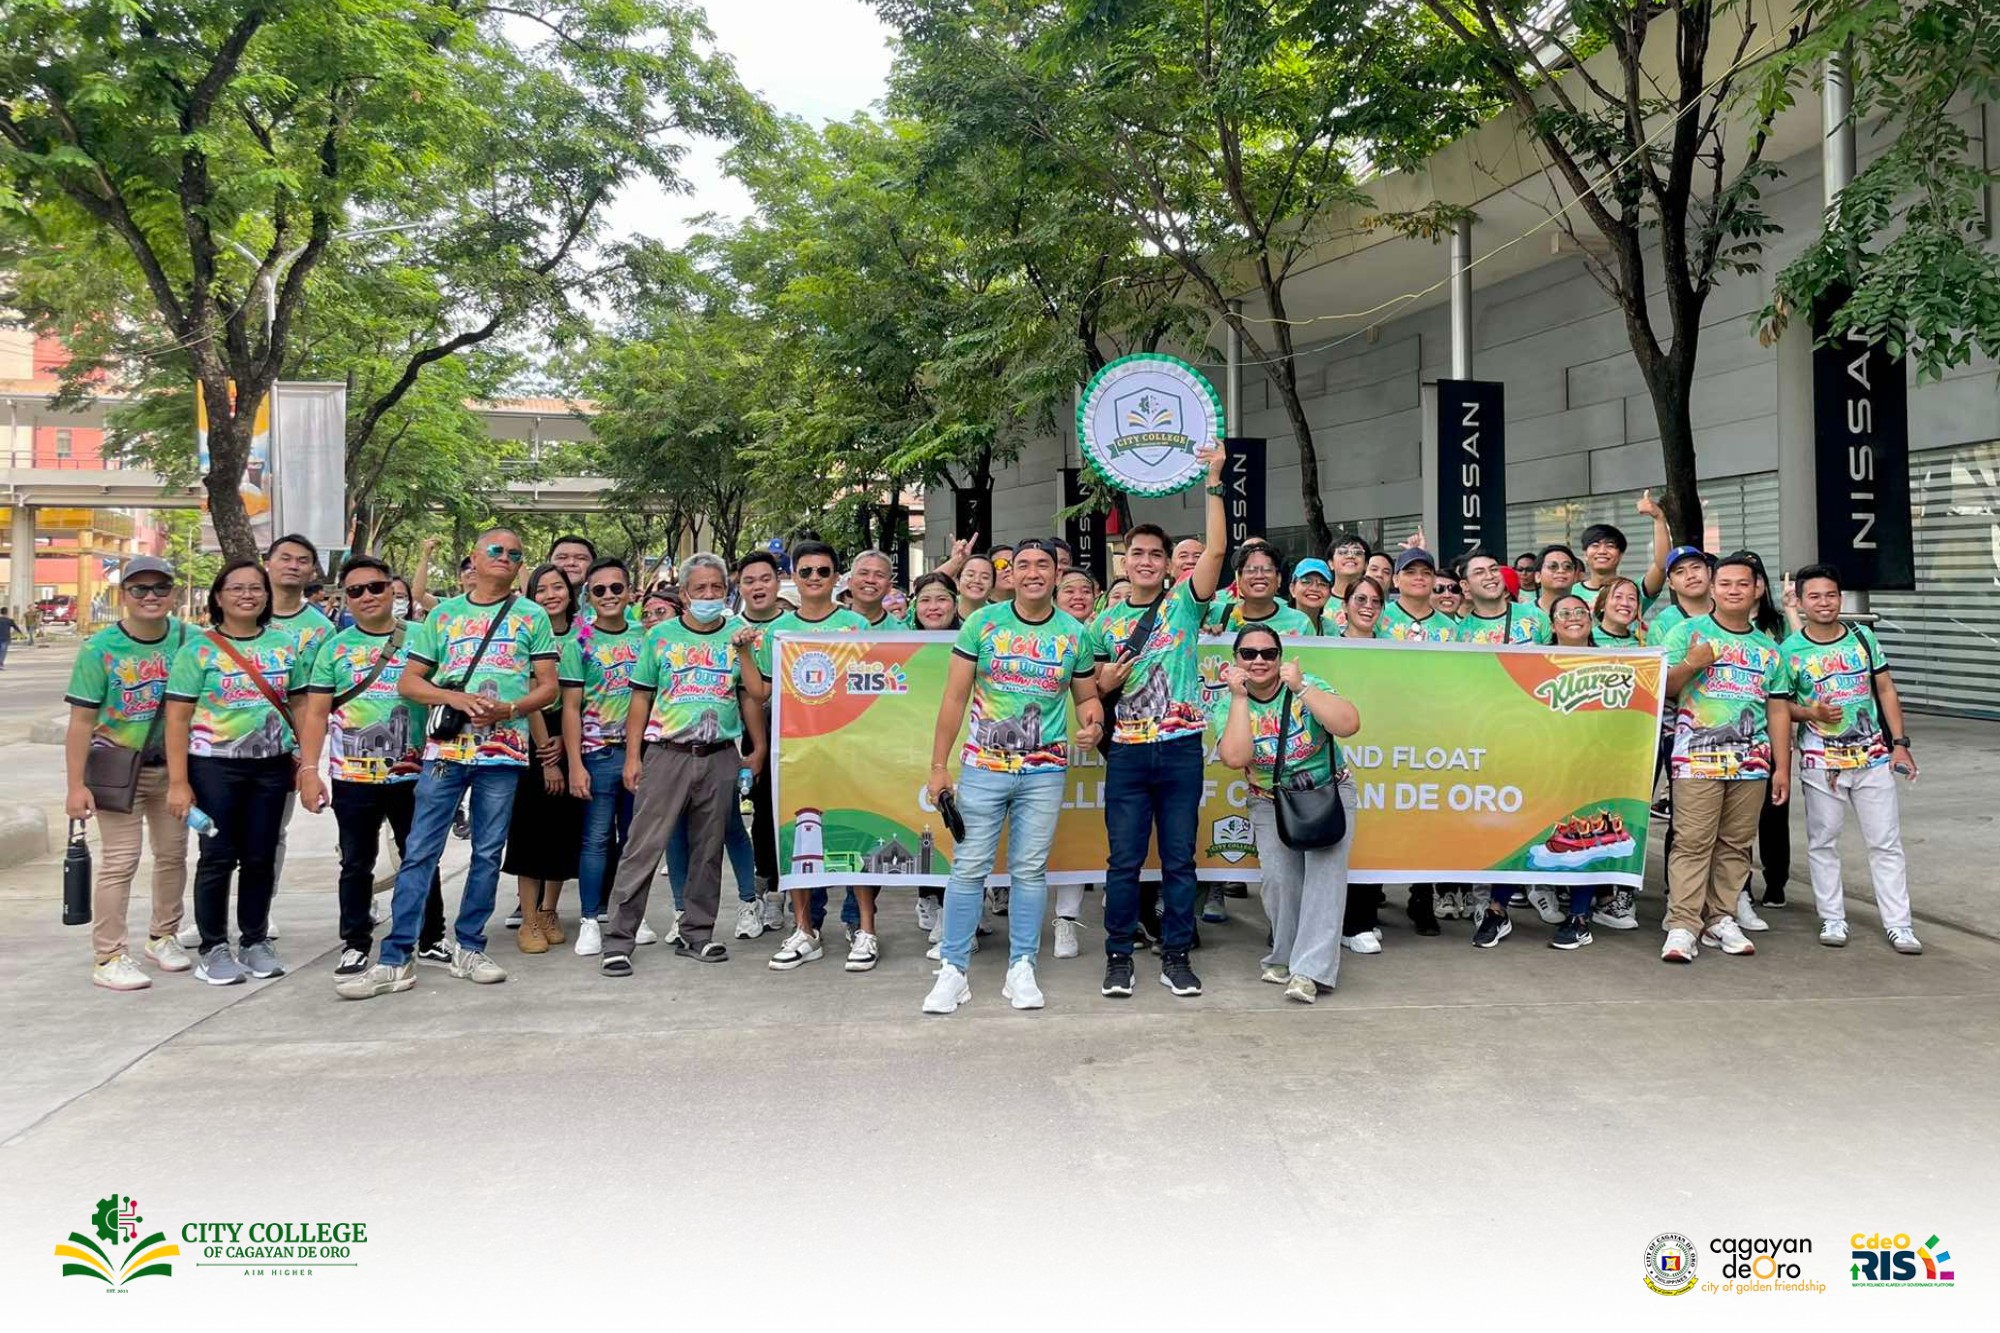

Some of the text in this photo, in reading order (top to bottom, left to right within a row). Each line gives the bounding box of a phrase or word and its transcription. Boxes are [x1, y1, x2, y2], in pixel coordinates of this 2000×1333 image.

[1117, 435, 1139, 447] CITY
[1142, 433, 1187, 444] COLLEGE
[848, 673, 885, 691] RIS
[1536, 672, 1633, 710] Klarex
[1603, 689, 1631, 707] UY
[1342, 745, 1487, 771] ND FLOAT
[1395, 783, 1440, 810] DE
[1448, 784, 1523, 813] ORO
